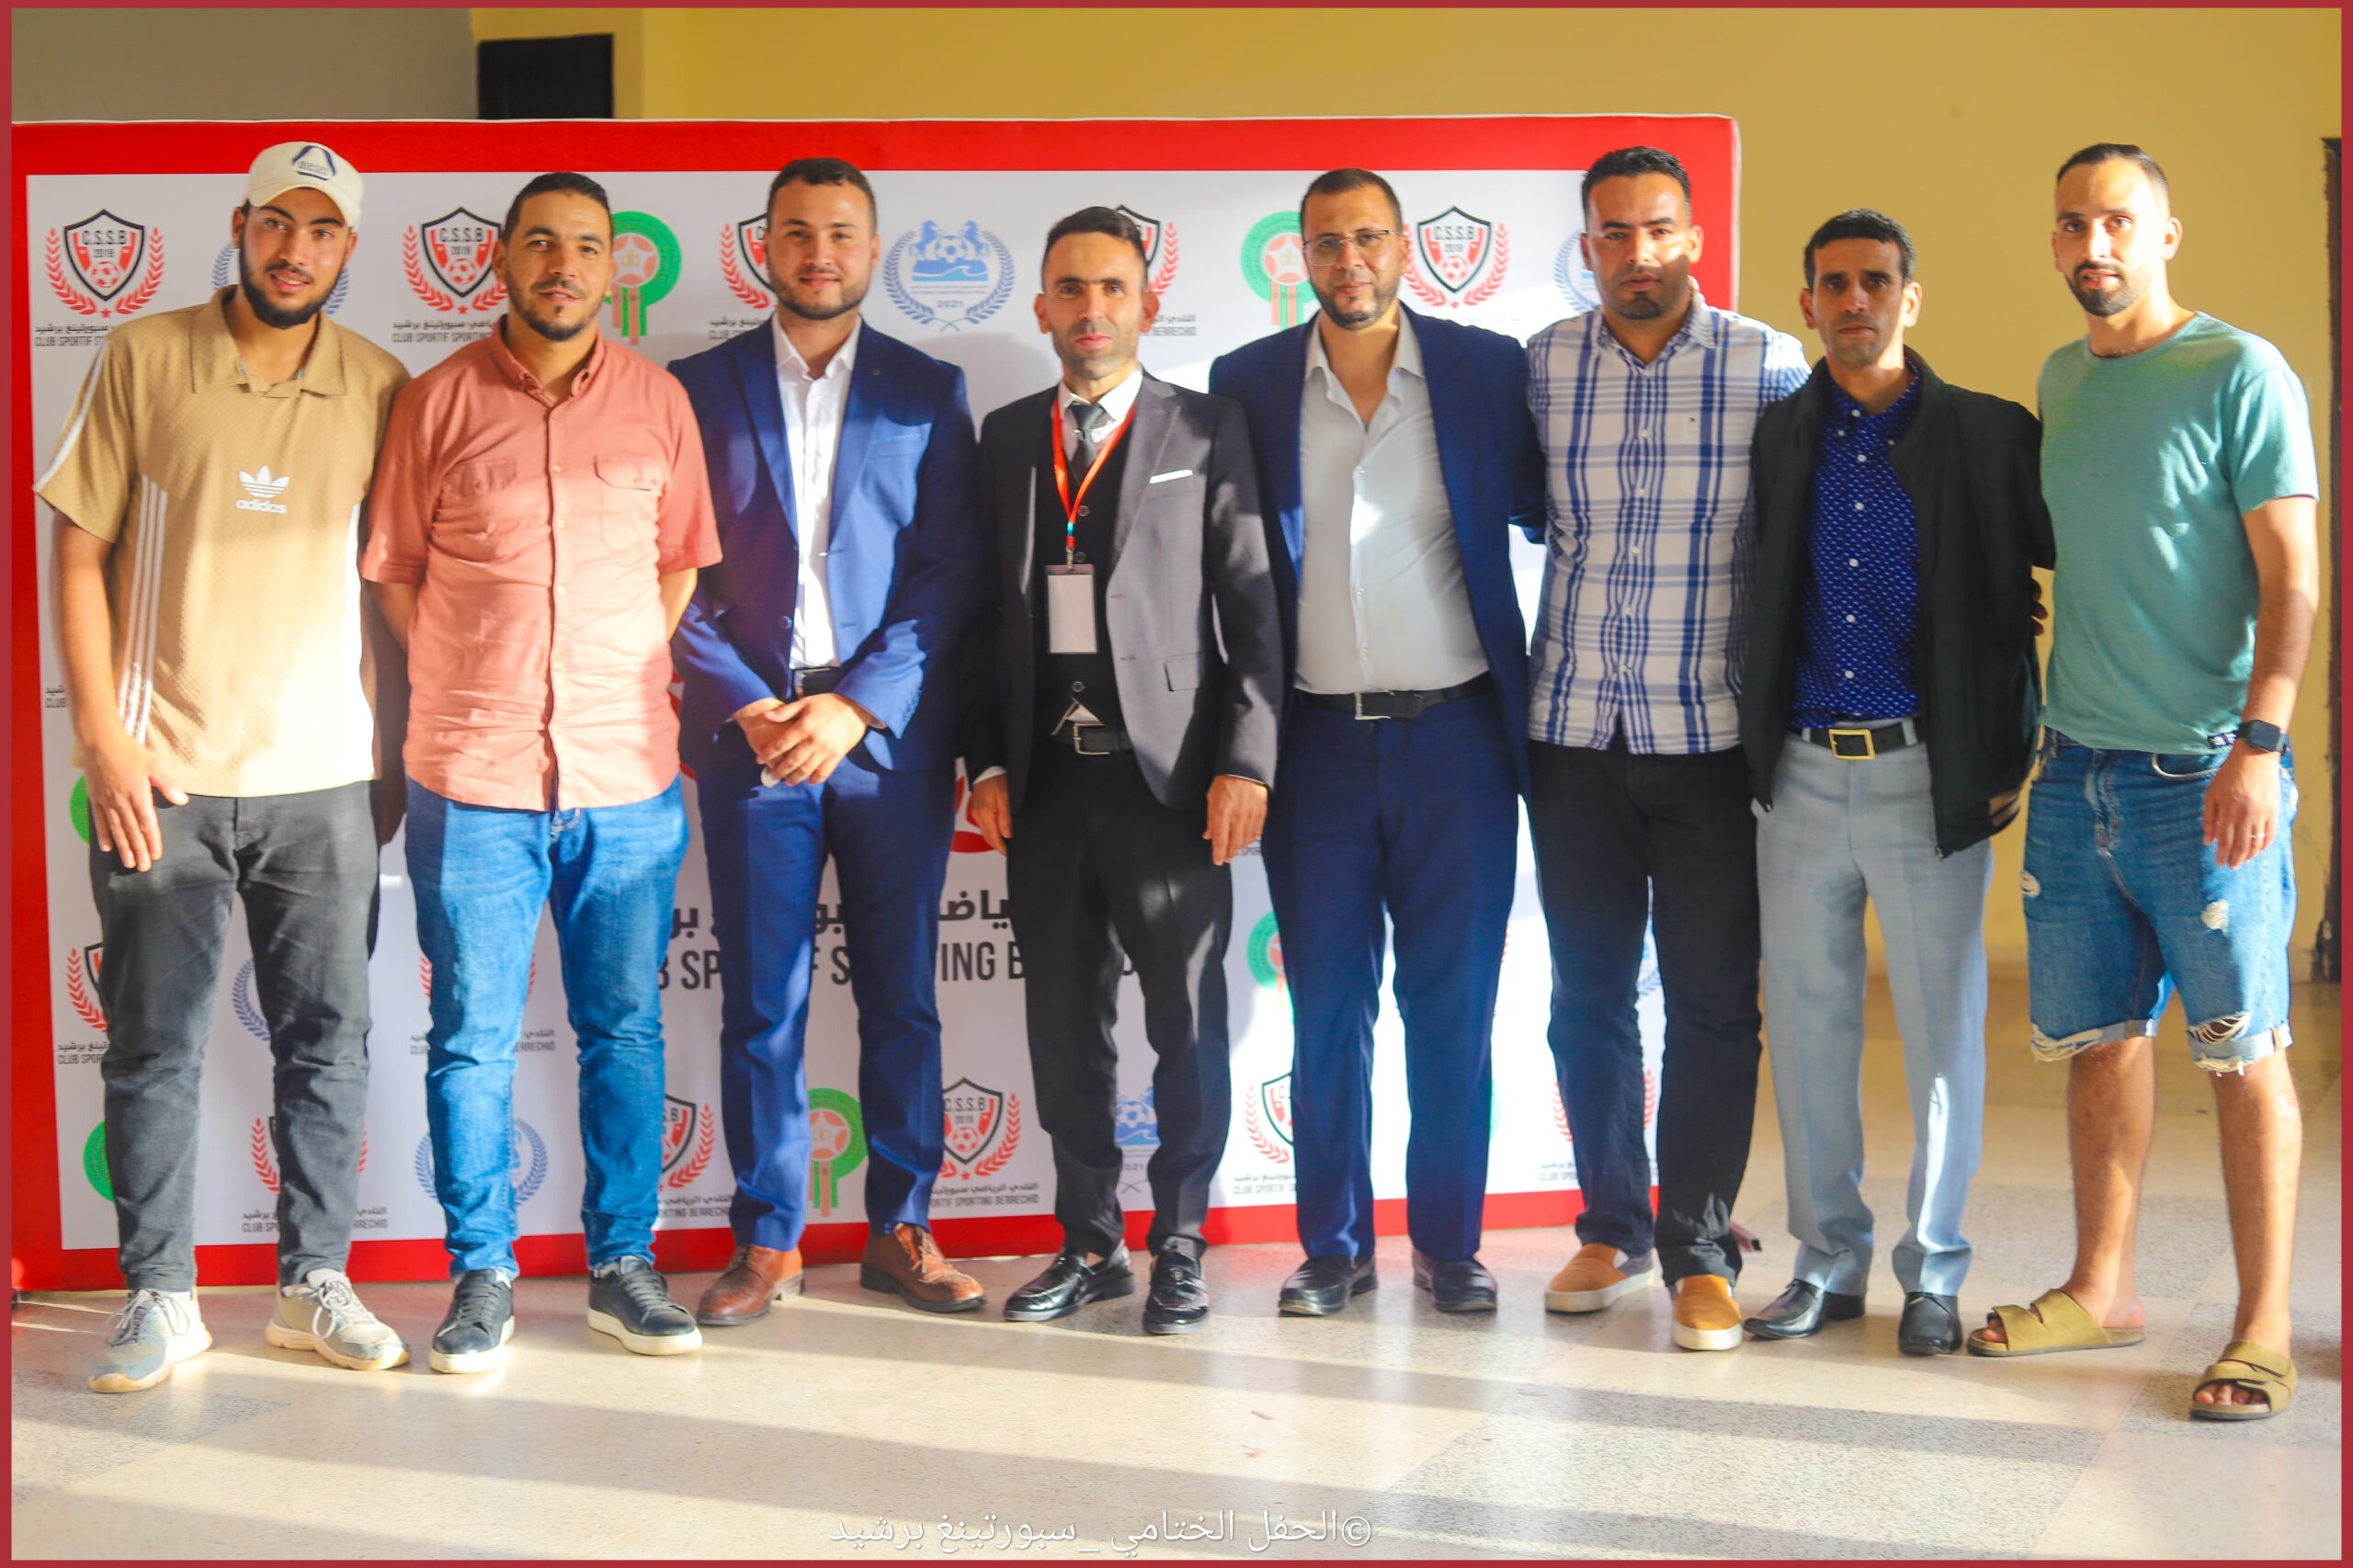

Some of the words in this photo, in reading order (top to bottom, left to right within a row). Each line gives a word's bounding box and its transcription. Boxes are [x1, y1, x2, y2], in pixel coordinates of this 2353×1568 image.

[82, 230, 127, 245] C.S.S.B
[439, 227, 483, 243] C.S.S.B
[1434, 225, 1474, 241] C.S.S.B
[34, 336, 56, 347] CLUB
[59, 335, 93, 347] SPORTIF
[392, 332, 413, 344] CLUB
[416, 331, 449, 343] SPORTIF
[235, 498, 288, 515] adidas
[58, 1054, 79, 1064] CLUB
[954, 1196, 993, 1208] SPORTING
[242, 1222, 263, 1233] CLUB
